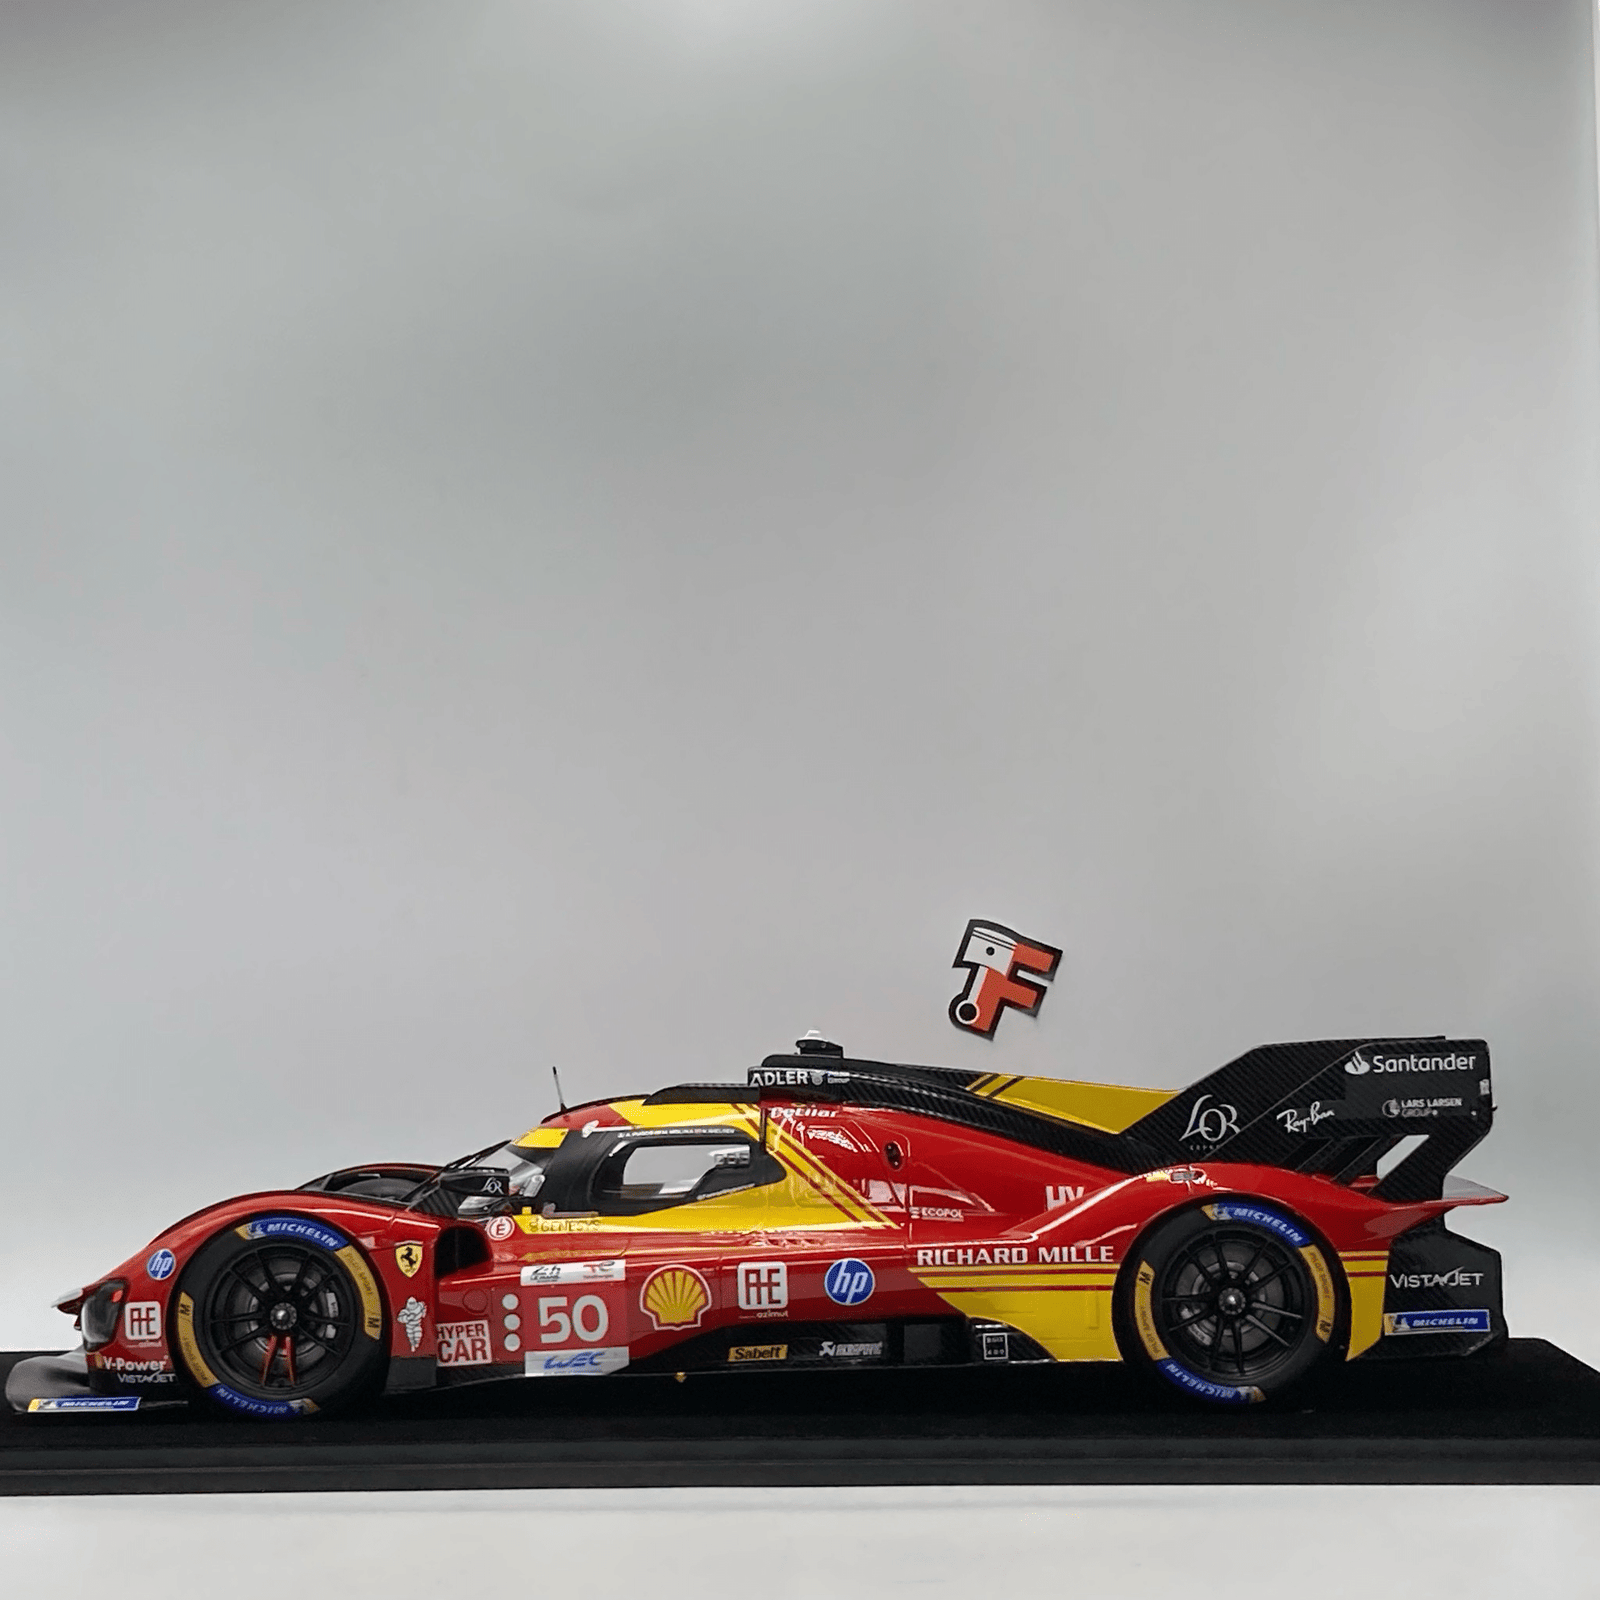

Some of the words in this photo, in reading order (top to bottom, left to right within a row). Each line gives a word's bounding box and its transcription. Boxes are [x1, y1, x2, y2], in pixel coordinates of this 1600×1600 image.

[1372, 1053, 1477, 1073] Santander
[749, 1071, 809, 1087] ADLER
[1401, 1098, 1425, 1107] LARS
[266, 1222, 339, 1247] MICHELIN
[1233, 1207, 1303, 1242] MICHELIN
[150, 1251, 173, 1279] hp
[917, 1247, 1029, 1266] RICHARD
[1038, 1245, 1114, 1264] MILLE
[832, 1259, 869, 1304] hp
[538, 1294, 609, 1344] 50
[1412, 1317, 1479, 1327] MICHELIN
[437, 1322, 486, 1340] HYPER
[437, 1337, 488, 1363] CAR
[735, 1346, 781, 1360] Sabelt
[103, 1356, 167, 1372] V-Power
[1165, 1363, 1237, 1399] MICHELIN
[61, 1400, 131, 1408] MICHELIN
[216, 1387, 289, 1414] MICHELIN
